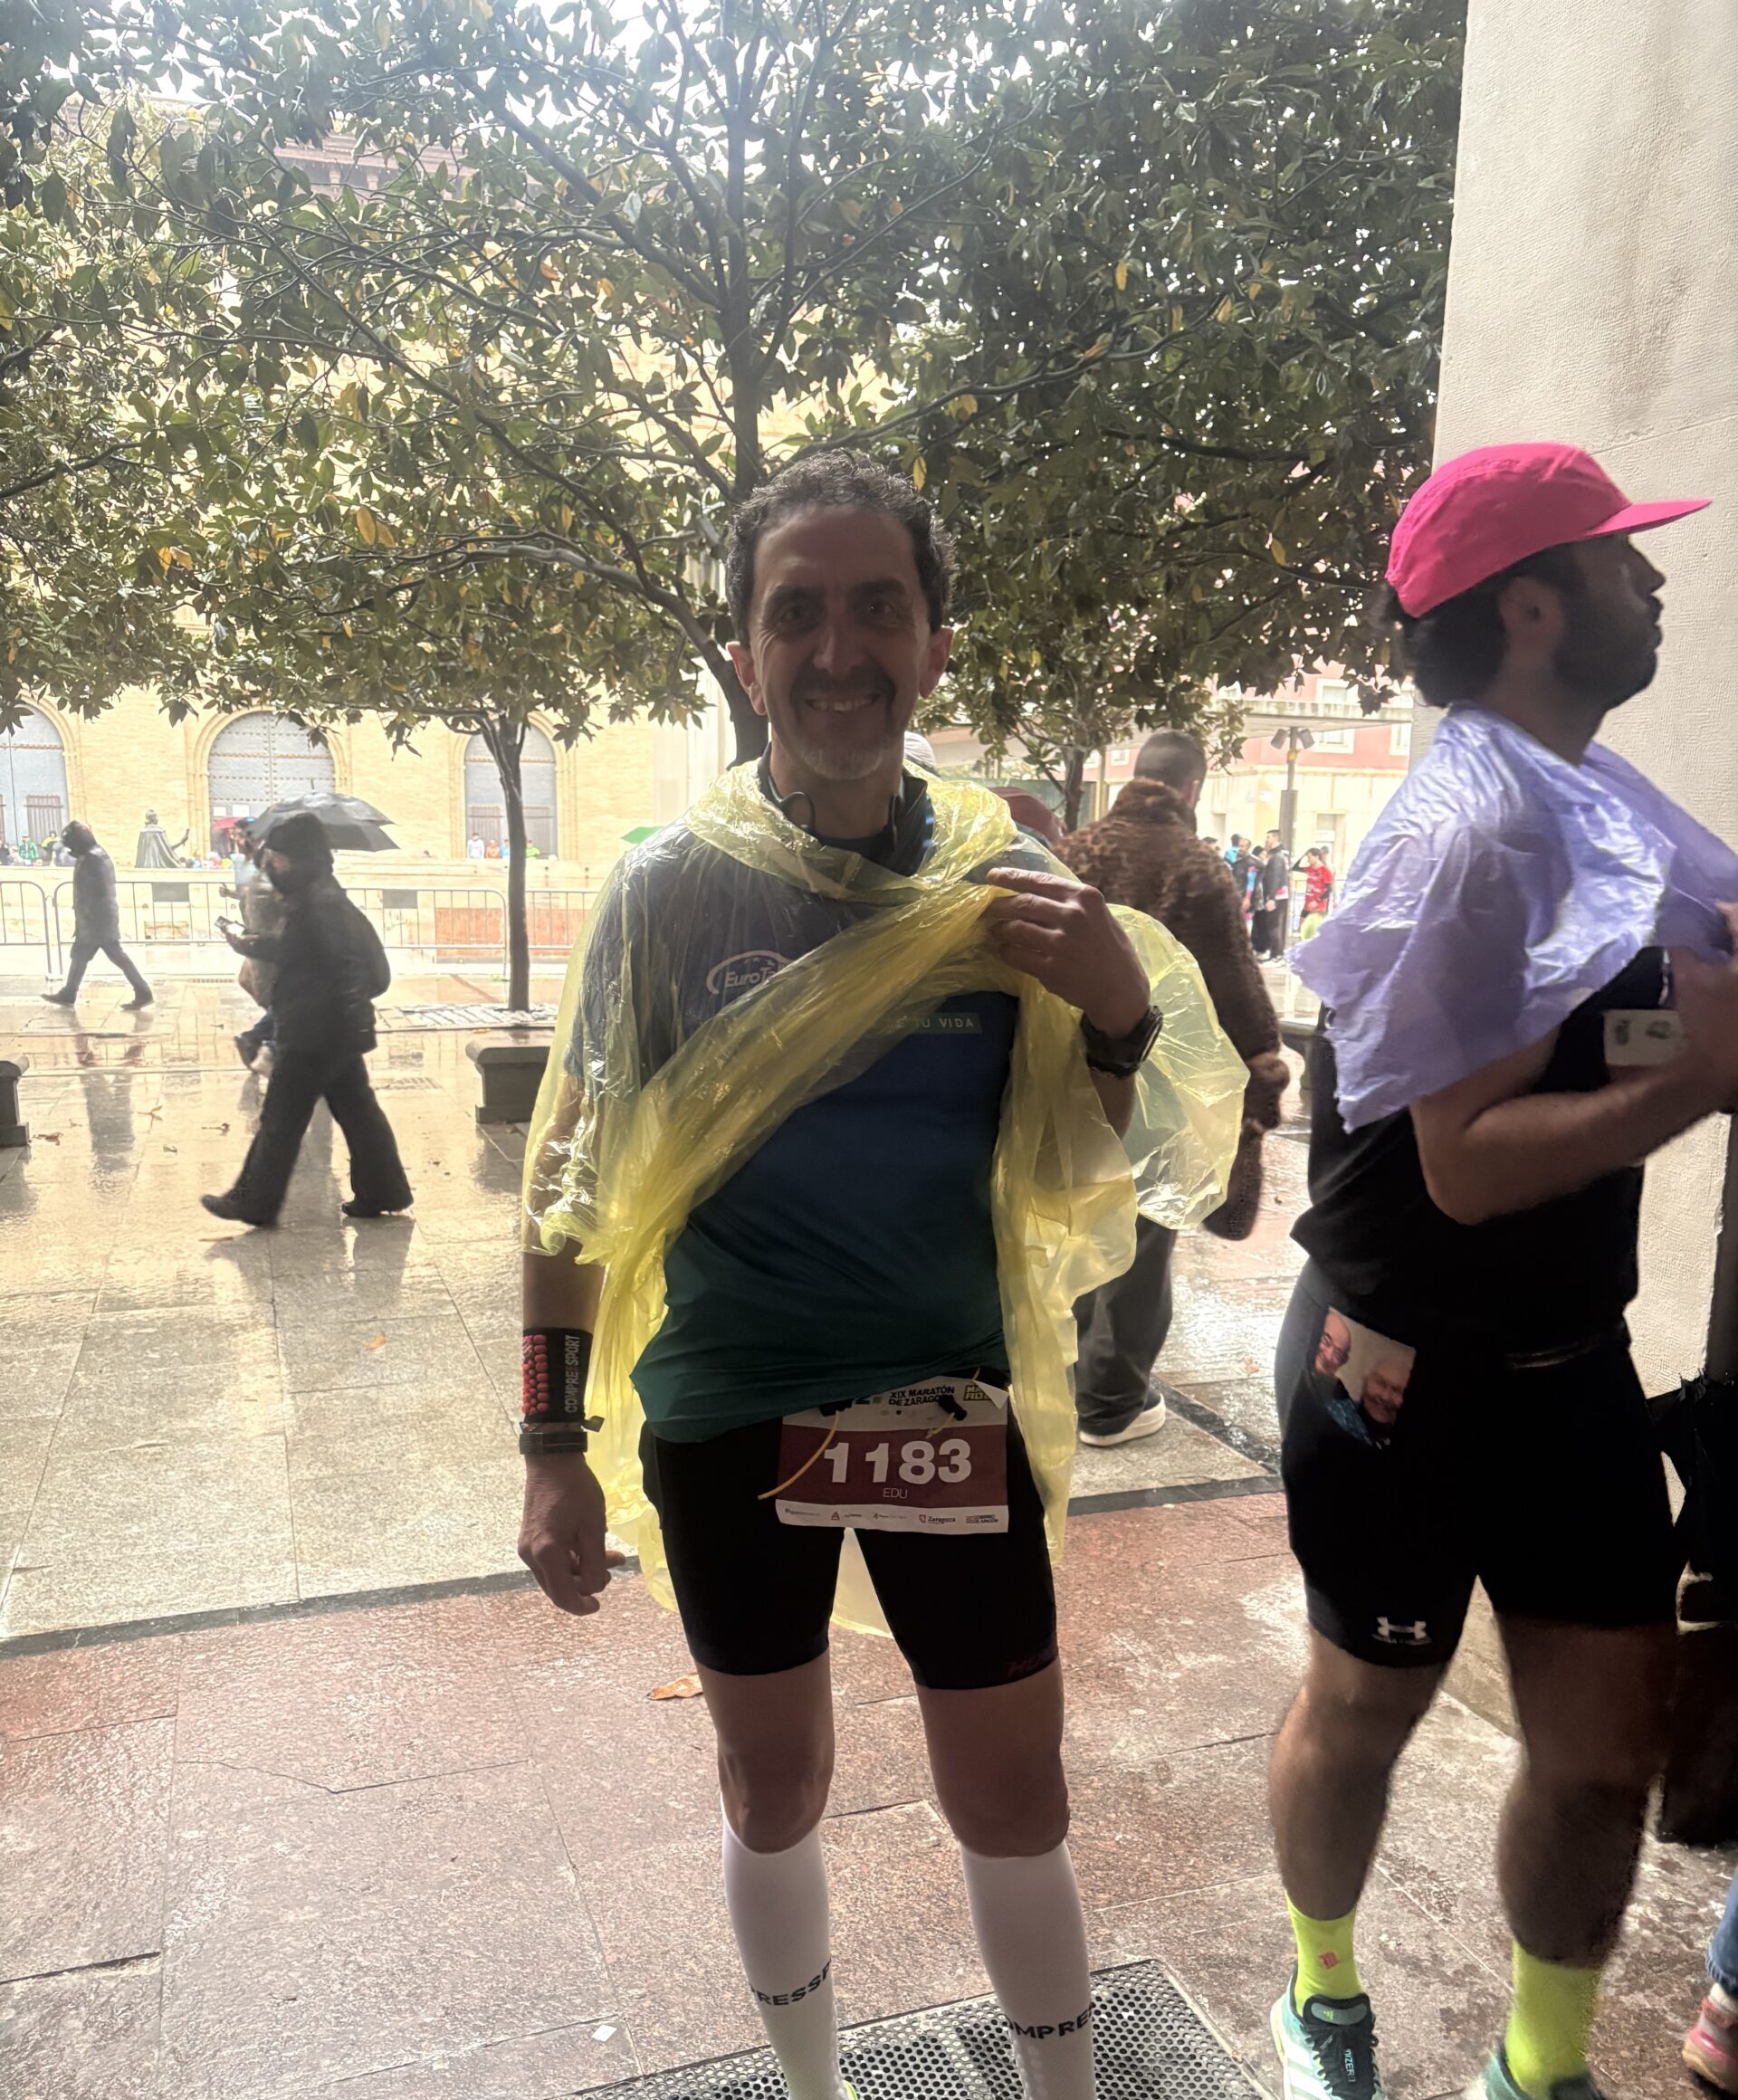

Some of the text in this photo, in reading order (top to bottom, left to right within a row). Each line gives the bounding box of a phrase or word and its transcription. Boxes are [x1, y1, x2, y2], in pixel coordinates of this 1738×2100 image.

[938, 1017, 975, 1028] VIDA
[890, 1385, 955, 1398] XIX MARATÓN
[904, 1394, 953, 1406] ZARAGO
[824, 1437, 972, 1485] 1183
[883, 1487, 908, 1499] EDU
[749, 1957, 832, 2006] RESSP
